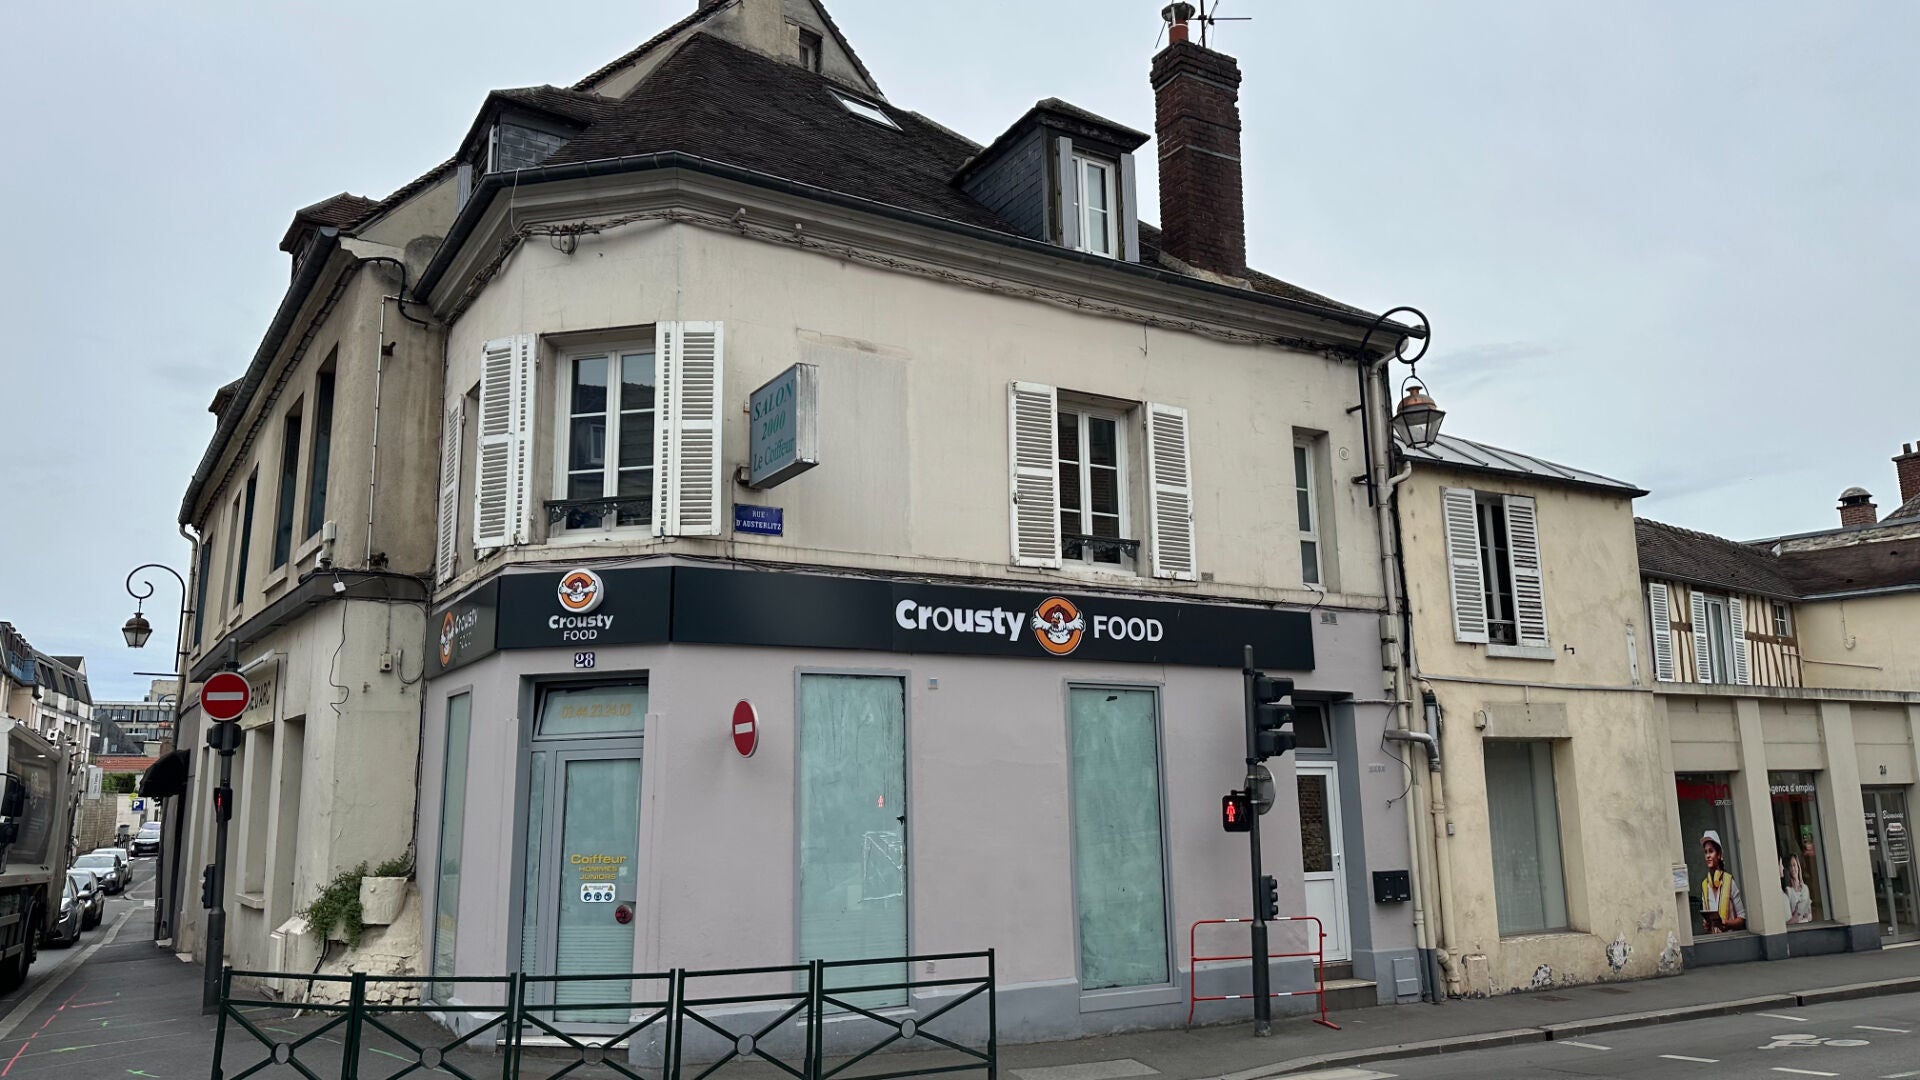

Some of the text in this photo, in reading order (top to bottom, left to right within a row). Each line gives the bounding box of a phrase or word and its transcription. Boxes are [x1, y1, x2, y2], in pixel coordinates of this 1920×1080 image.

[753, 379, 795, 422] SALON
[761, 411, 787, 441] 2000
[753, 437, 795, 473] Le Coiffeur
[752, 510, 765, 518] RUE
[736, 519, 782, 531] D'AUSTERLITZ
[548, 614, 614, 629] Crousty
[895, 599, 1164, 642] Crousty FOOD
[563, 630, 598, 640] FOOD
[575, 653, 594, 668] 28
[1769, 784, 1790, 795] gence
[571, 854, 627, 864] Coiffeur
